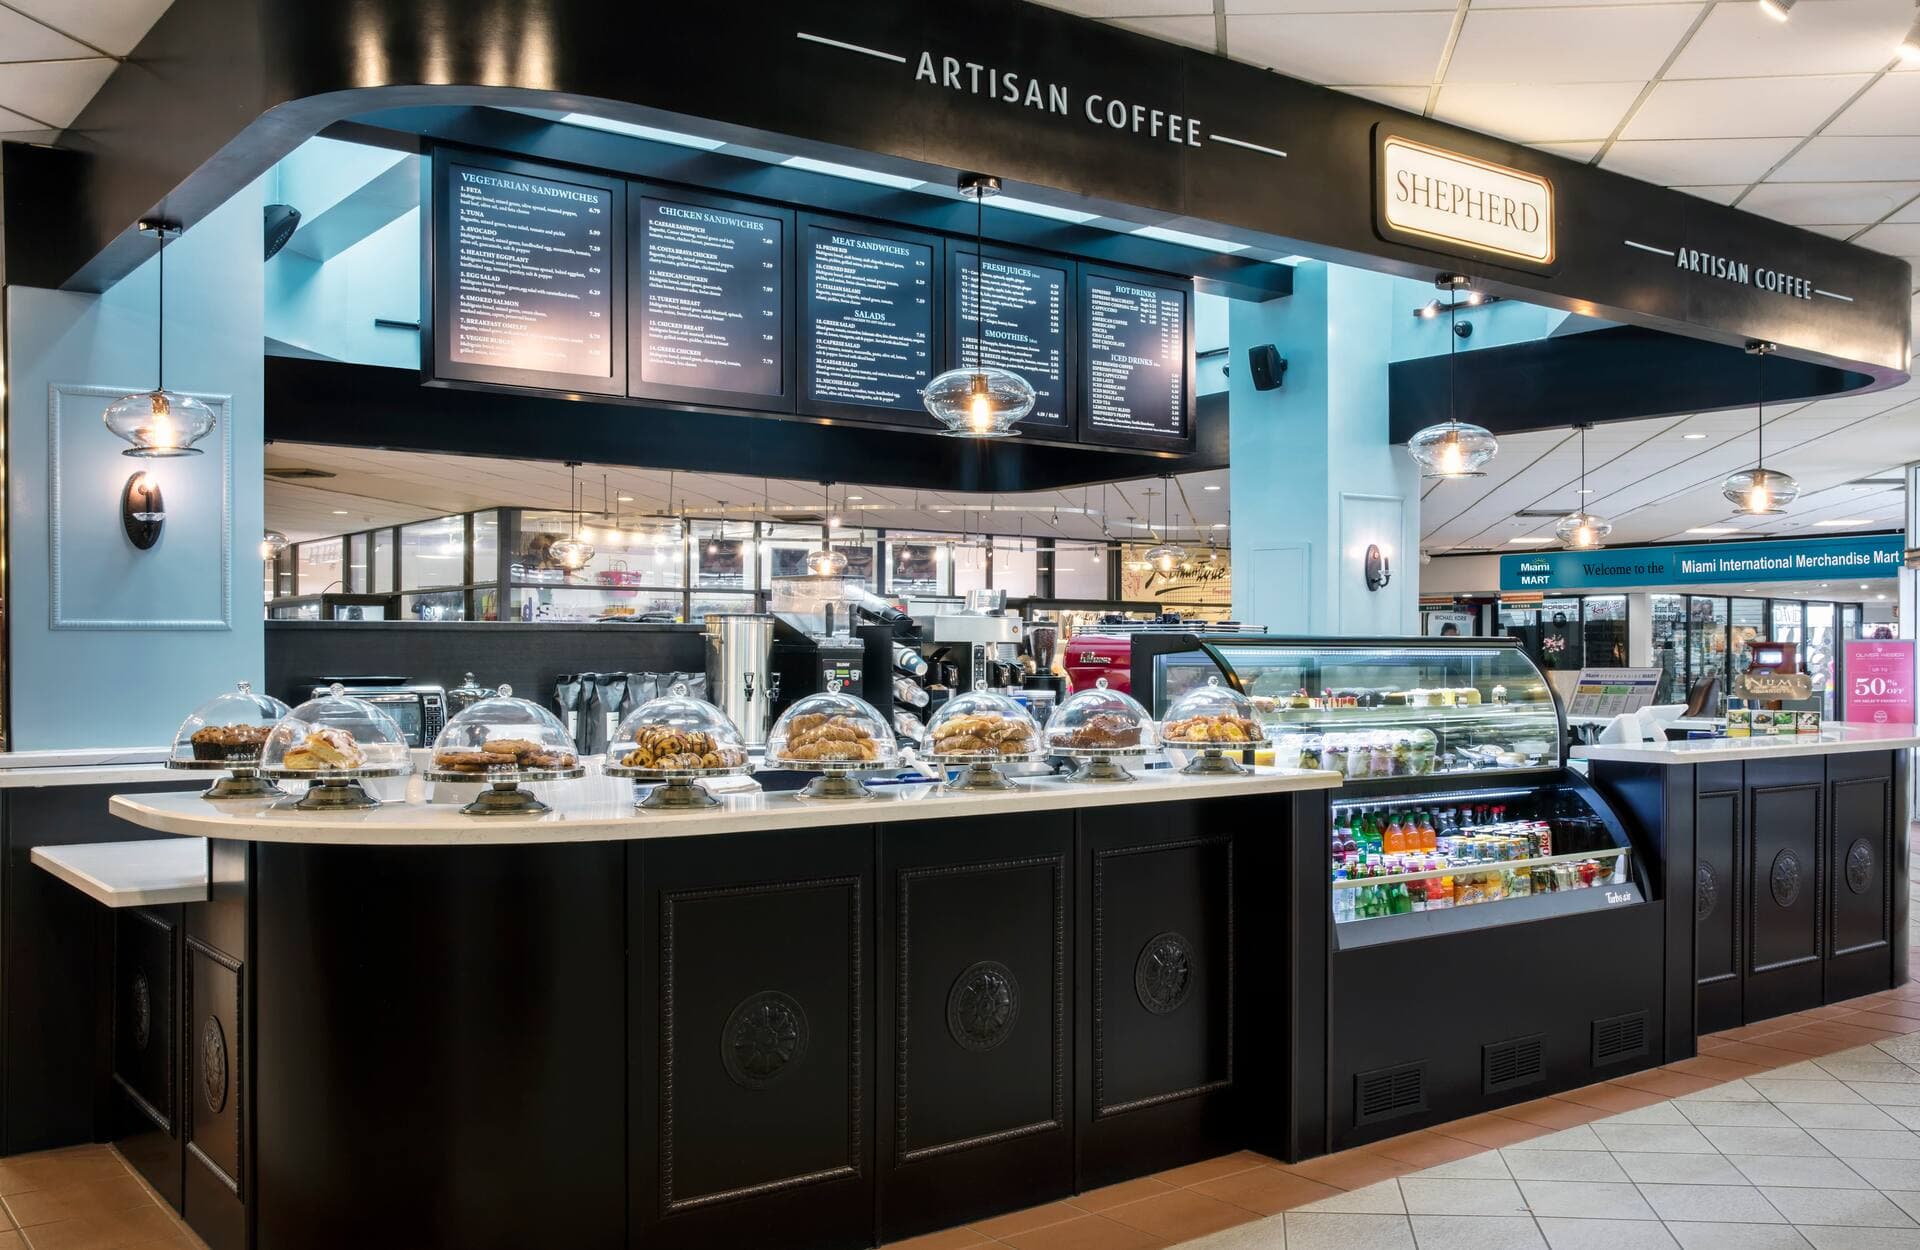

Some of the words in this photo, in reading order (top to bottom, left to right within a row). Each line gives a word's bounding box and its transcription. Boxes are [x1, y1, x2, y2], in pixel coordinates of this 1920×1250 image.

[915, 50, 1069, 116] ARTISAN
[1085, 94, 1202, 147] COFFEE
[461, 172, 529, 192] VEGETARIAN
[531, 184, 598, 204] SANDWICHES
[1396, 169, 1540, 234] SHEPHERD
[659, 206, 701, 220] CHICKEN
[704, 213, 763, 230] SANDWICHES
[466, 226, 497, 235] AVOCADO
[832, 236, 855, 246] MEAT
[857, 240, 909, 255] SANDWICHES
[466, 249, 496, 258] HEALTHY
[497, 253, 529, 263] EGGPLANT
[982, 262, 1005, 272] FRESH
[1006, 266, 1030, 277] JUICES
[1677, 246, 1749, 284] ARTISAN
[1754, 268, 1812, 300] COFFEE
[466, 295, 492, 303] SMOKED
[1115, 285, 1130, 293] HOT
[1131, 288, 1155, 298] DRINKS
[854, 310, 885, 320] SALADS
[985, 329, 1028, 341] SMOOTHIES
[1111, 354, 1127, 362] ICED
[1128, 356, 1152, 365] DRINKS
[1520, 562, 1550, 572] Miami
[1583, 563, 1631, 577] Welcome
[1634, 564, 1645, 575] to
[1647, 562, 1664, 574] the
[1682, 559, 1717, 574] Miami
[1719, 556, 1792, 572] International
[1796, 552, 1870, 568] Merchandise
[1873, 550, 1899, 563] Mart
[1521, 575, 1550, 584] MART
[1855, 678, 1886, 695] 50
